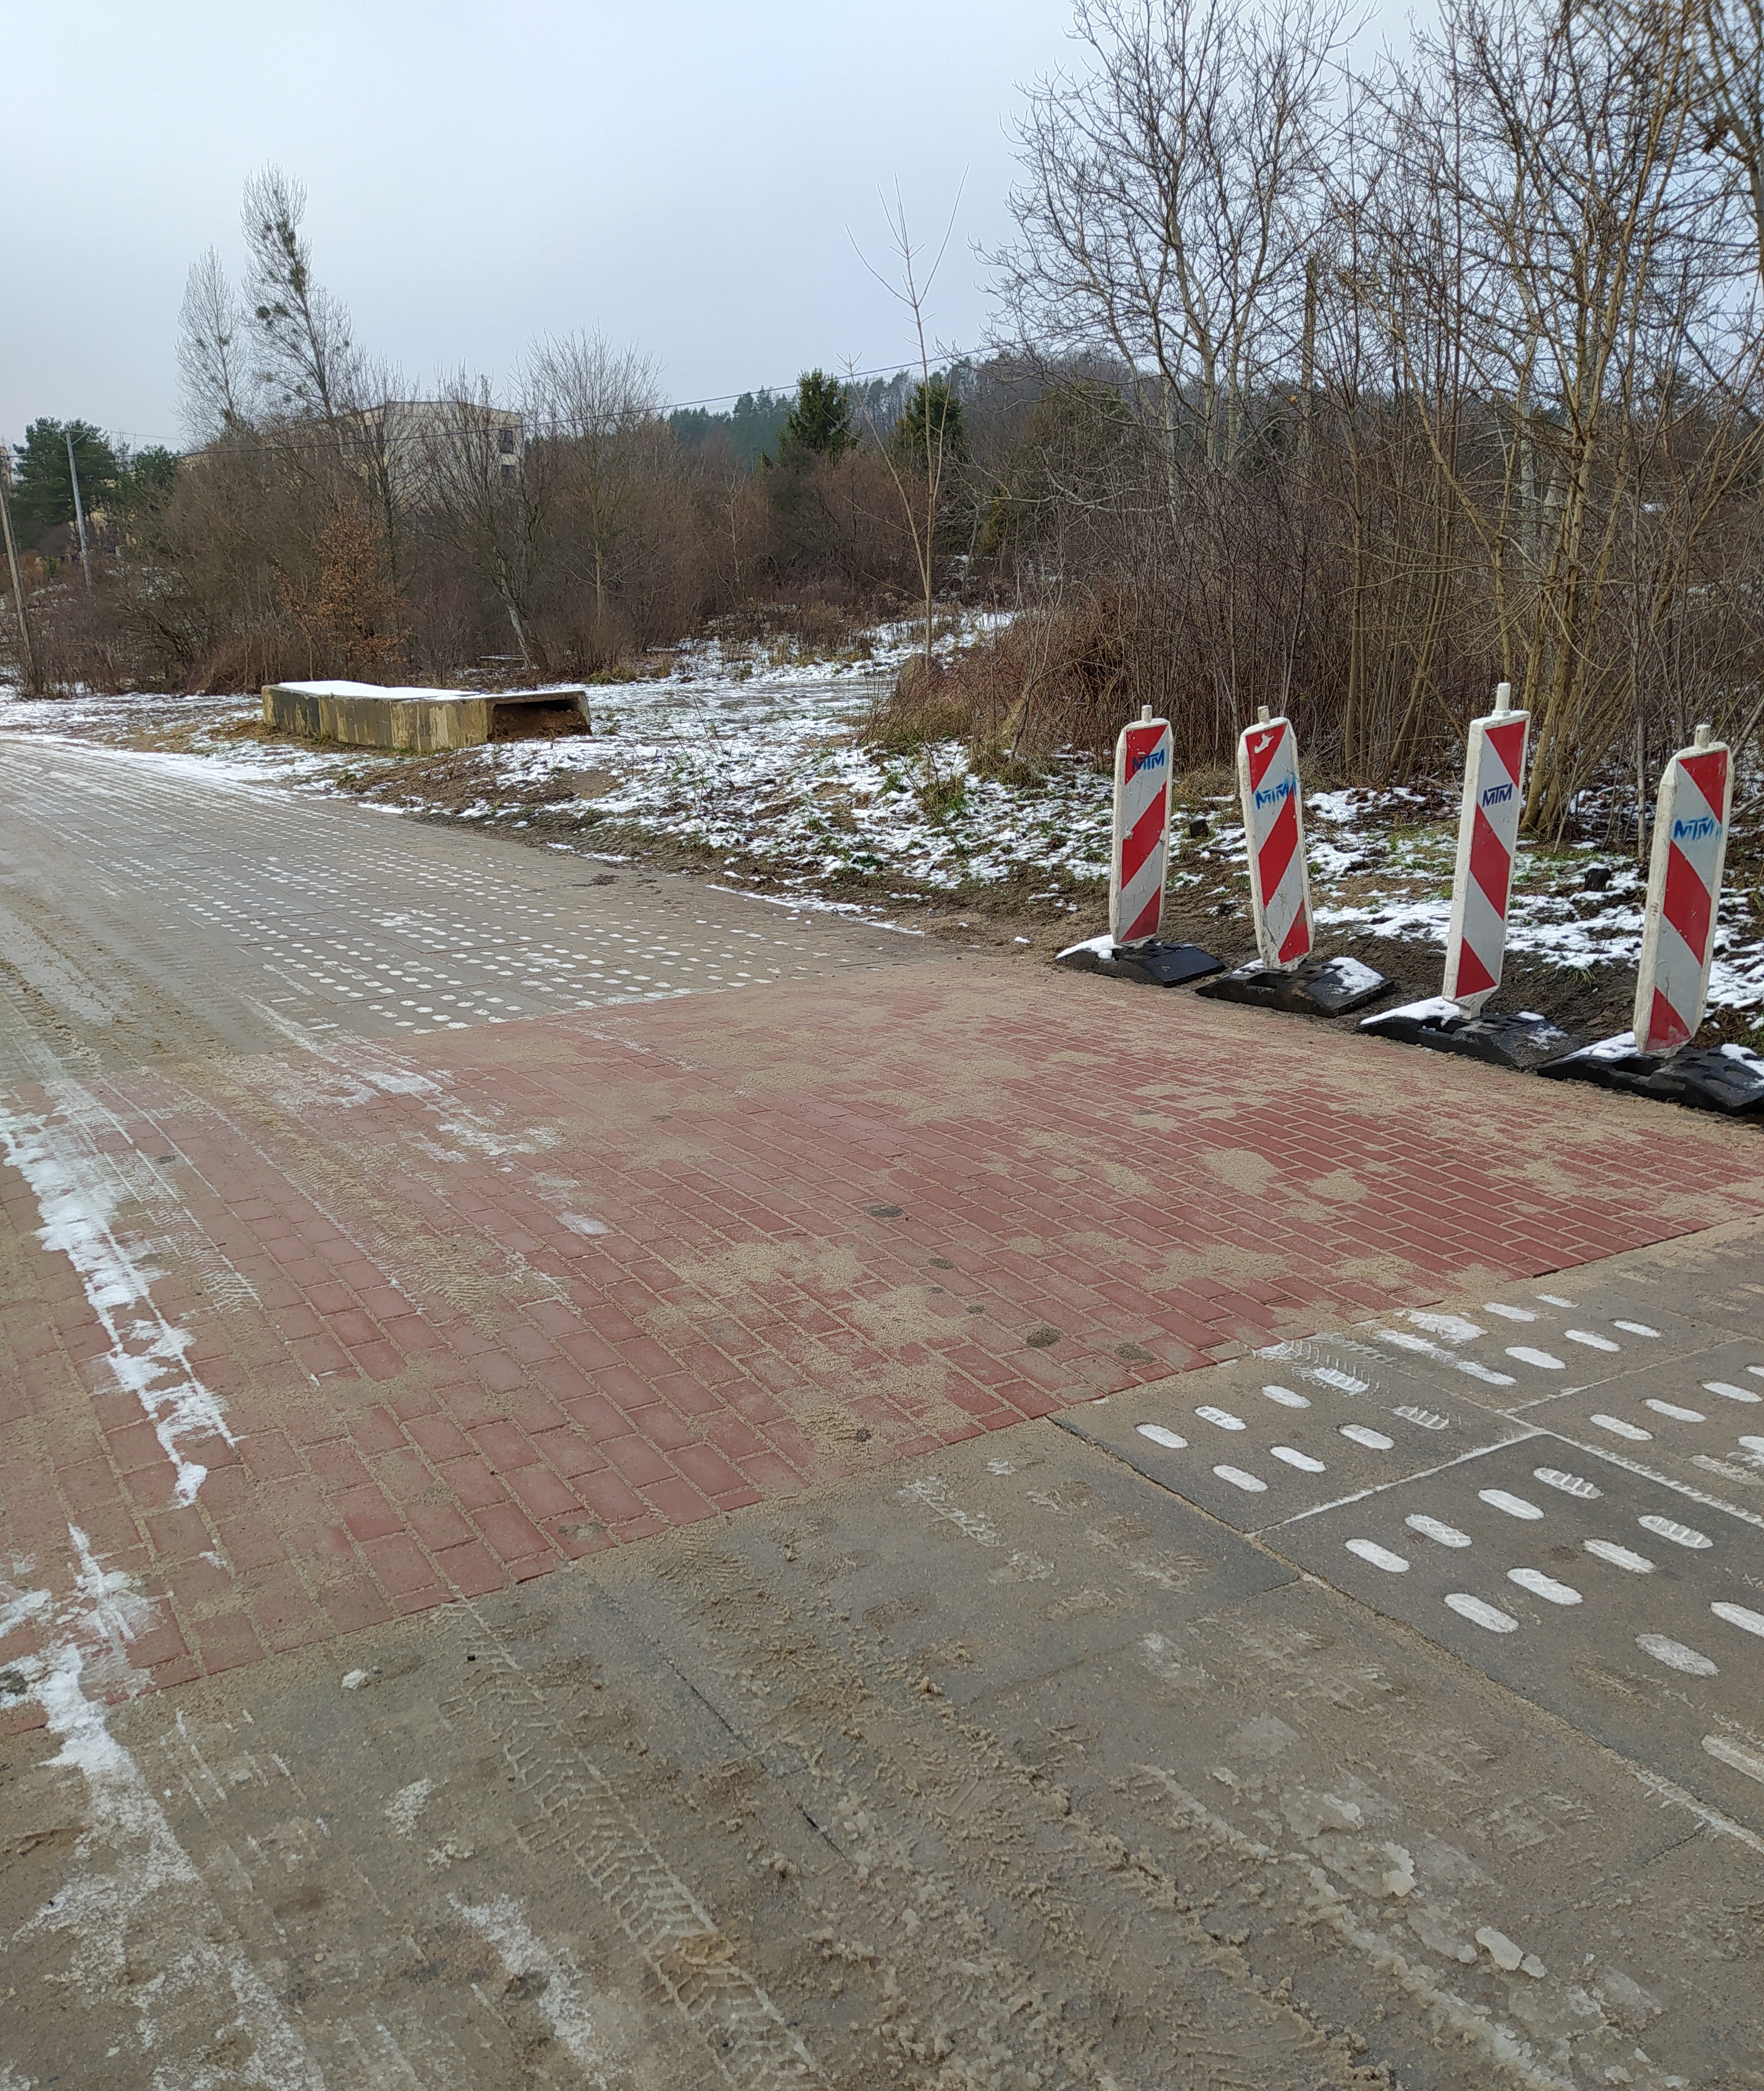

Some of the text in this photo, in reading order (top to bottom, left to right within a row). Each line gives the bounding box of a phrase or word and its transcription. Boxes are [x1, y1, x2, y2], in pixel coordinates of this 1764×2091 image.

[1132, 749, 1165, 772] MTM
[1255, 776, 1297, 810] MTM
[1482, 783, 1513, 808] MTM
[1673, 816, 1715, 840] MTM
